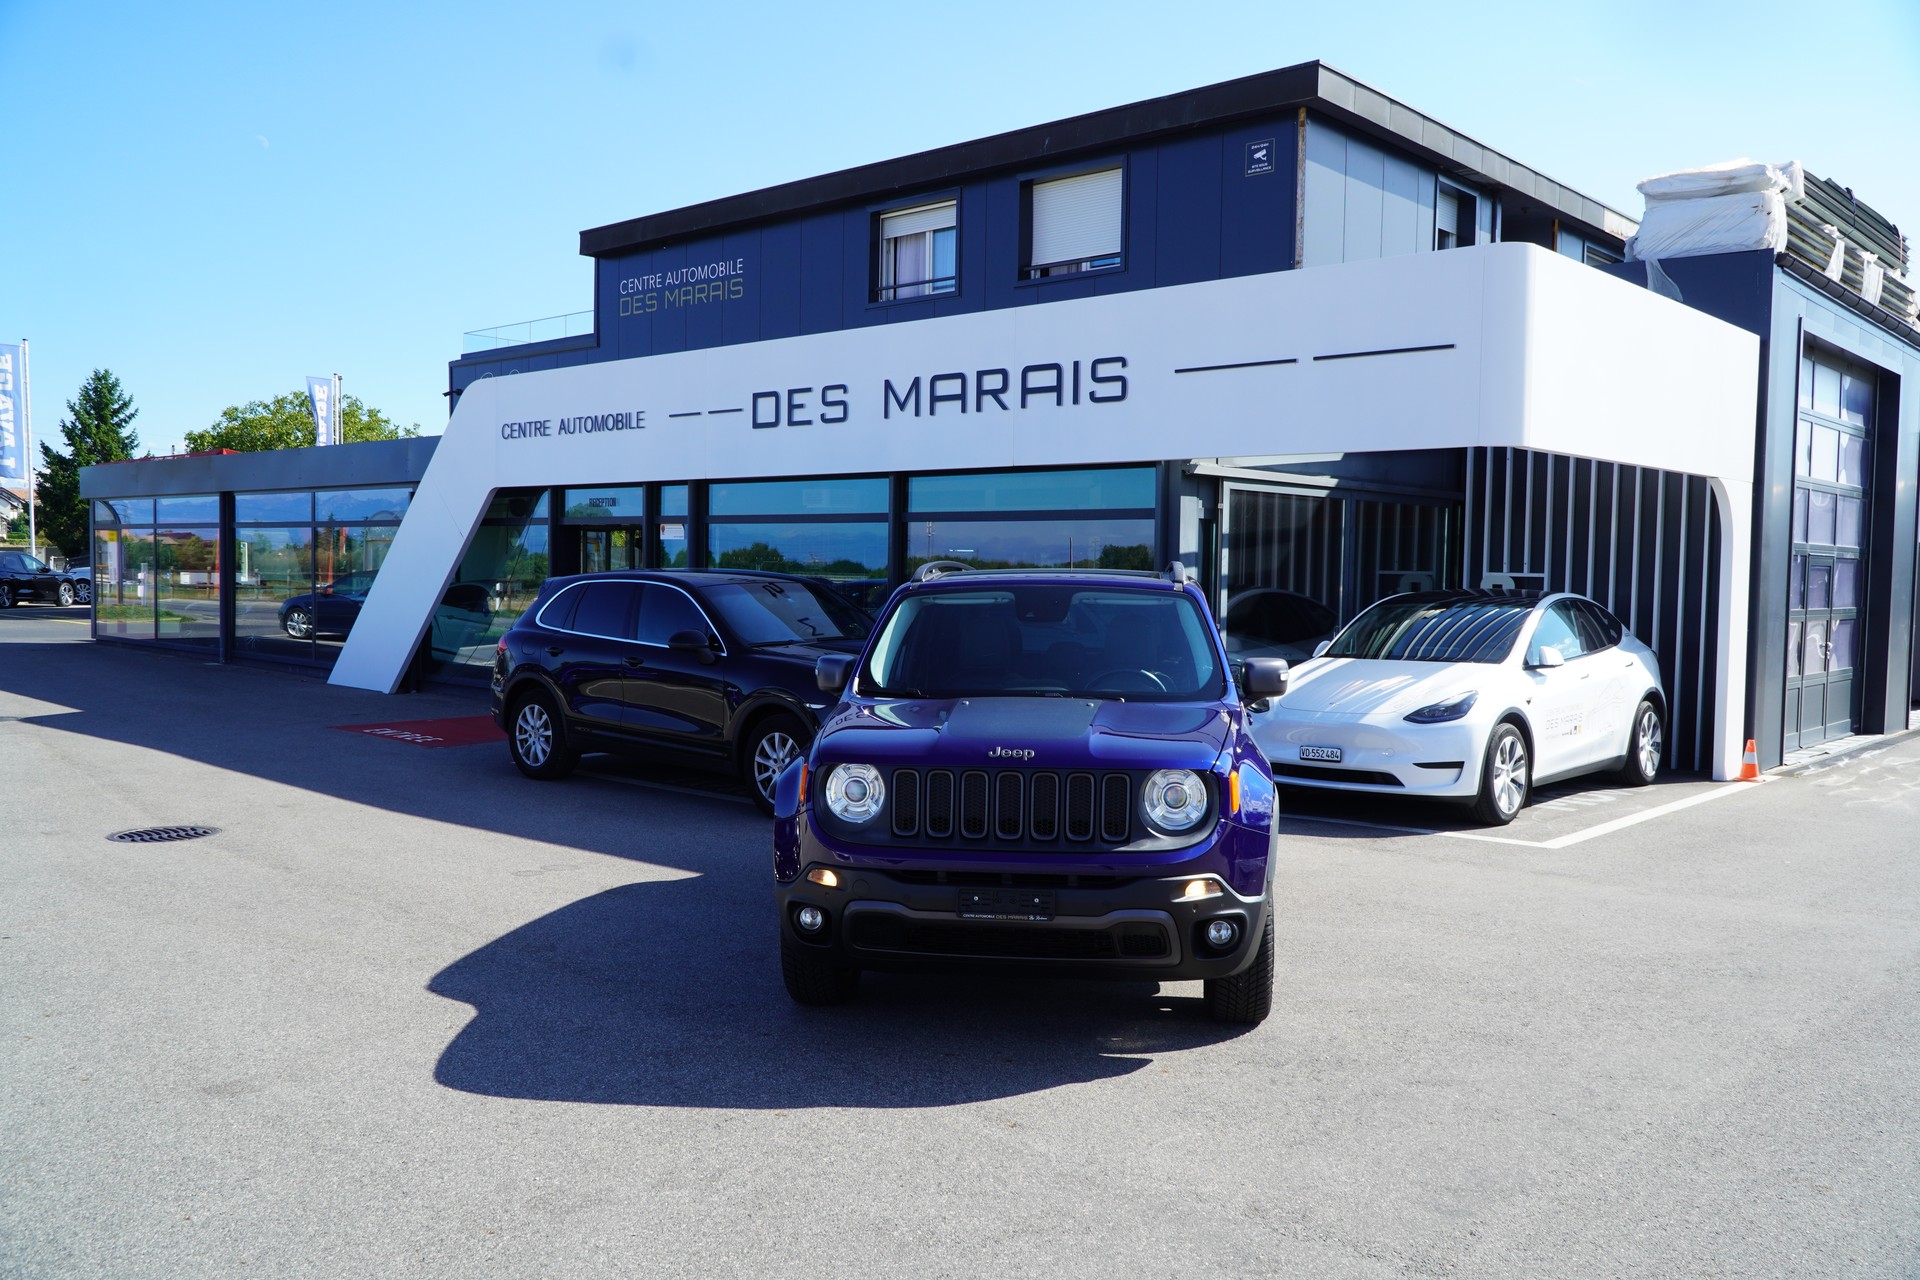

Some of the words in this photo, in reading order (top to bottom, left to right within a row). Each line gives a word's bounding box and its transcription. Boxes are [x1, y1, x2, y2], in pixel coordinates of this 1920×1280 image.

[619, 273, 662, 295] CENTRE
[665, 258, 743, 286] AUTOMOBILE
[619, 292, 657, 316] DES
[664, 278, 743, 309] MARAIS
[752, 383, 848, 429] DES
[883, 356, 1128, 419] MARAIS
[501, 419, 551, 440] CENTRE
[558, 411, 645, 435] AUTOMOBILE
[987, 746, 1035, 761] Jeep
